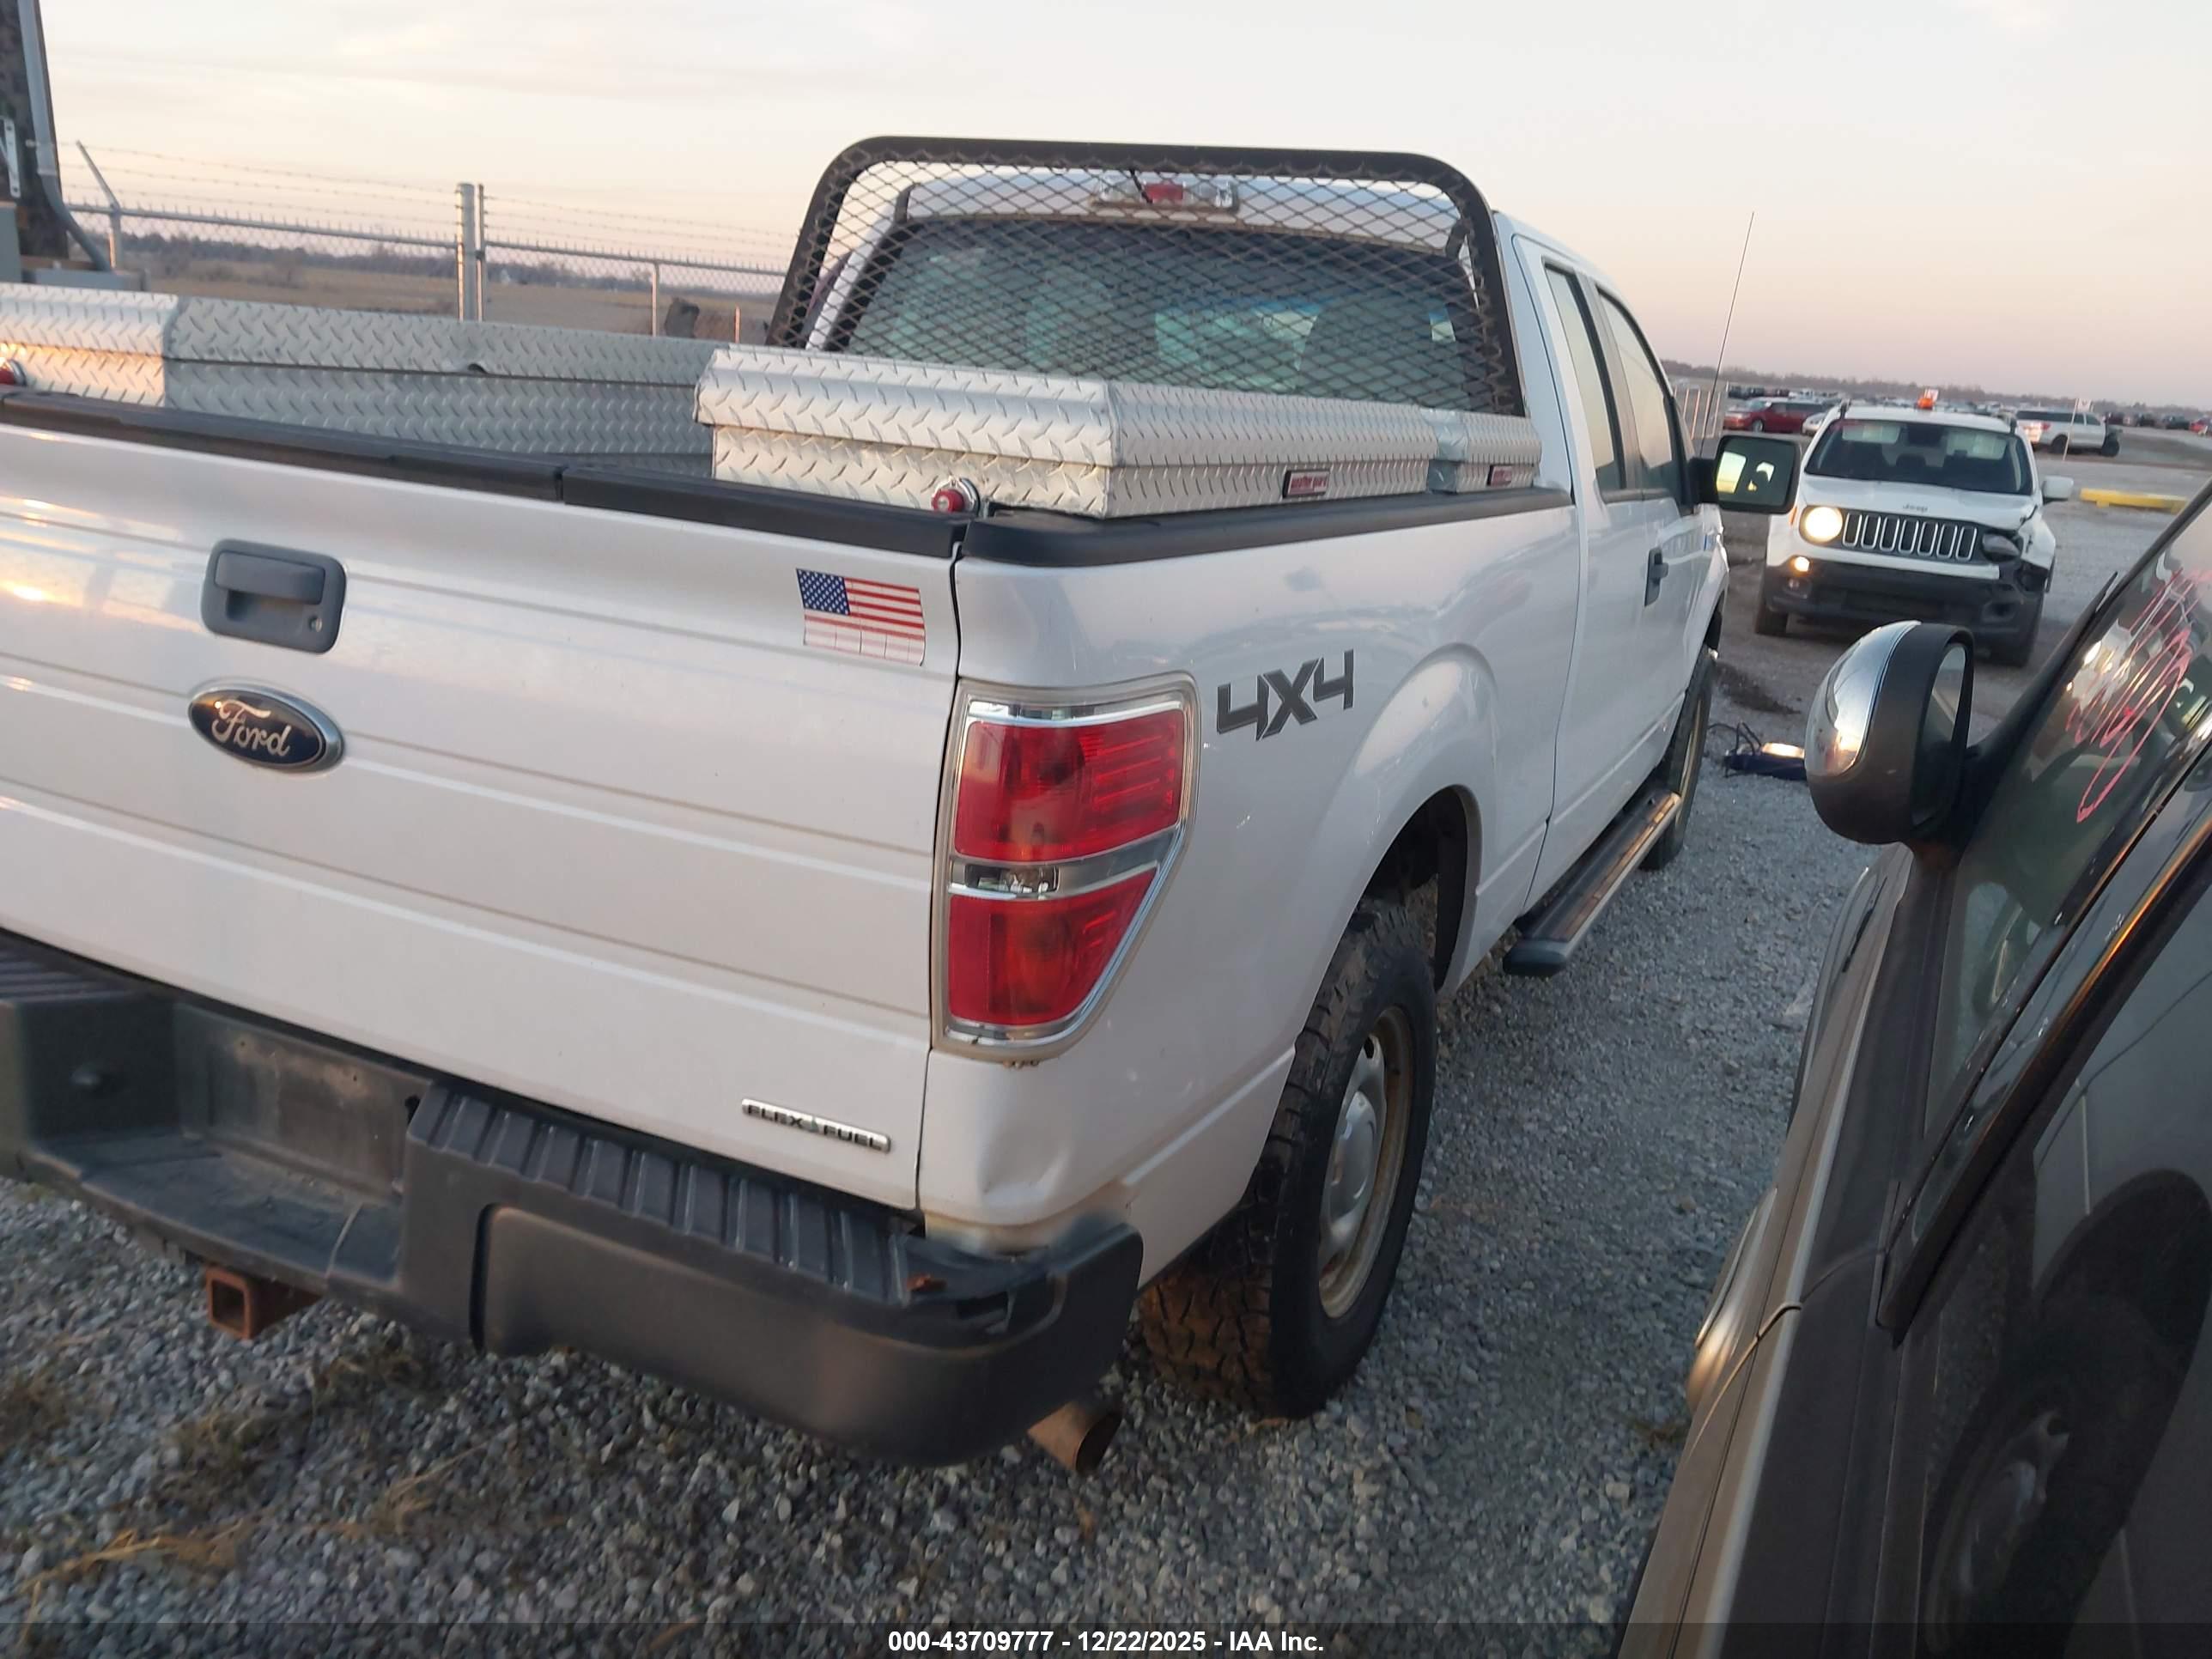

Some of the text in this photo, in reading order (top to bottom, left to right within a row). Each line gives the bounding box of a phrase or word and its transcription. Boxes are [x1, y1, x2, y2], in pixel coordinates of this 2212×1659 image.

[211, 698, 292, 757] Ford
[748, 1104, 883, 1152] FLEX FUEL
